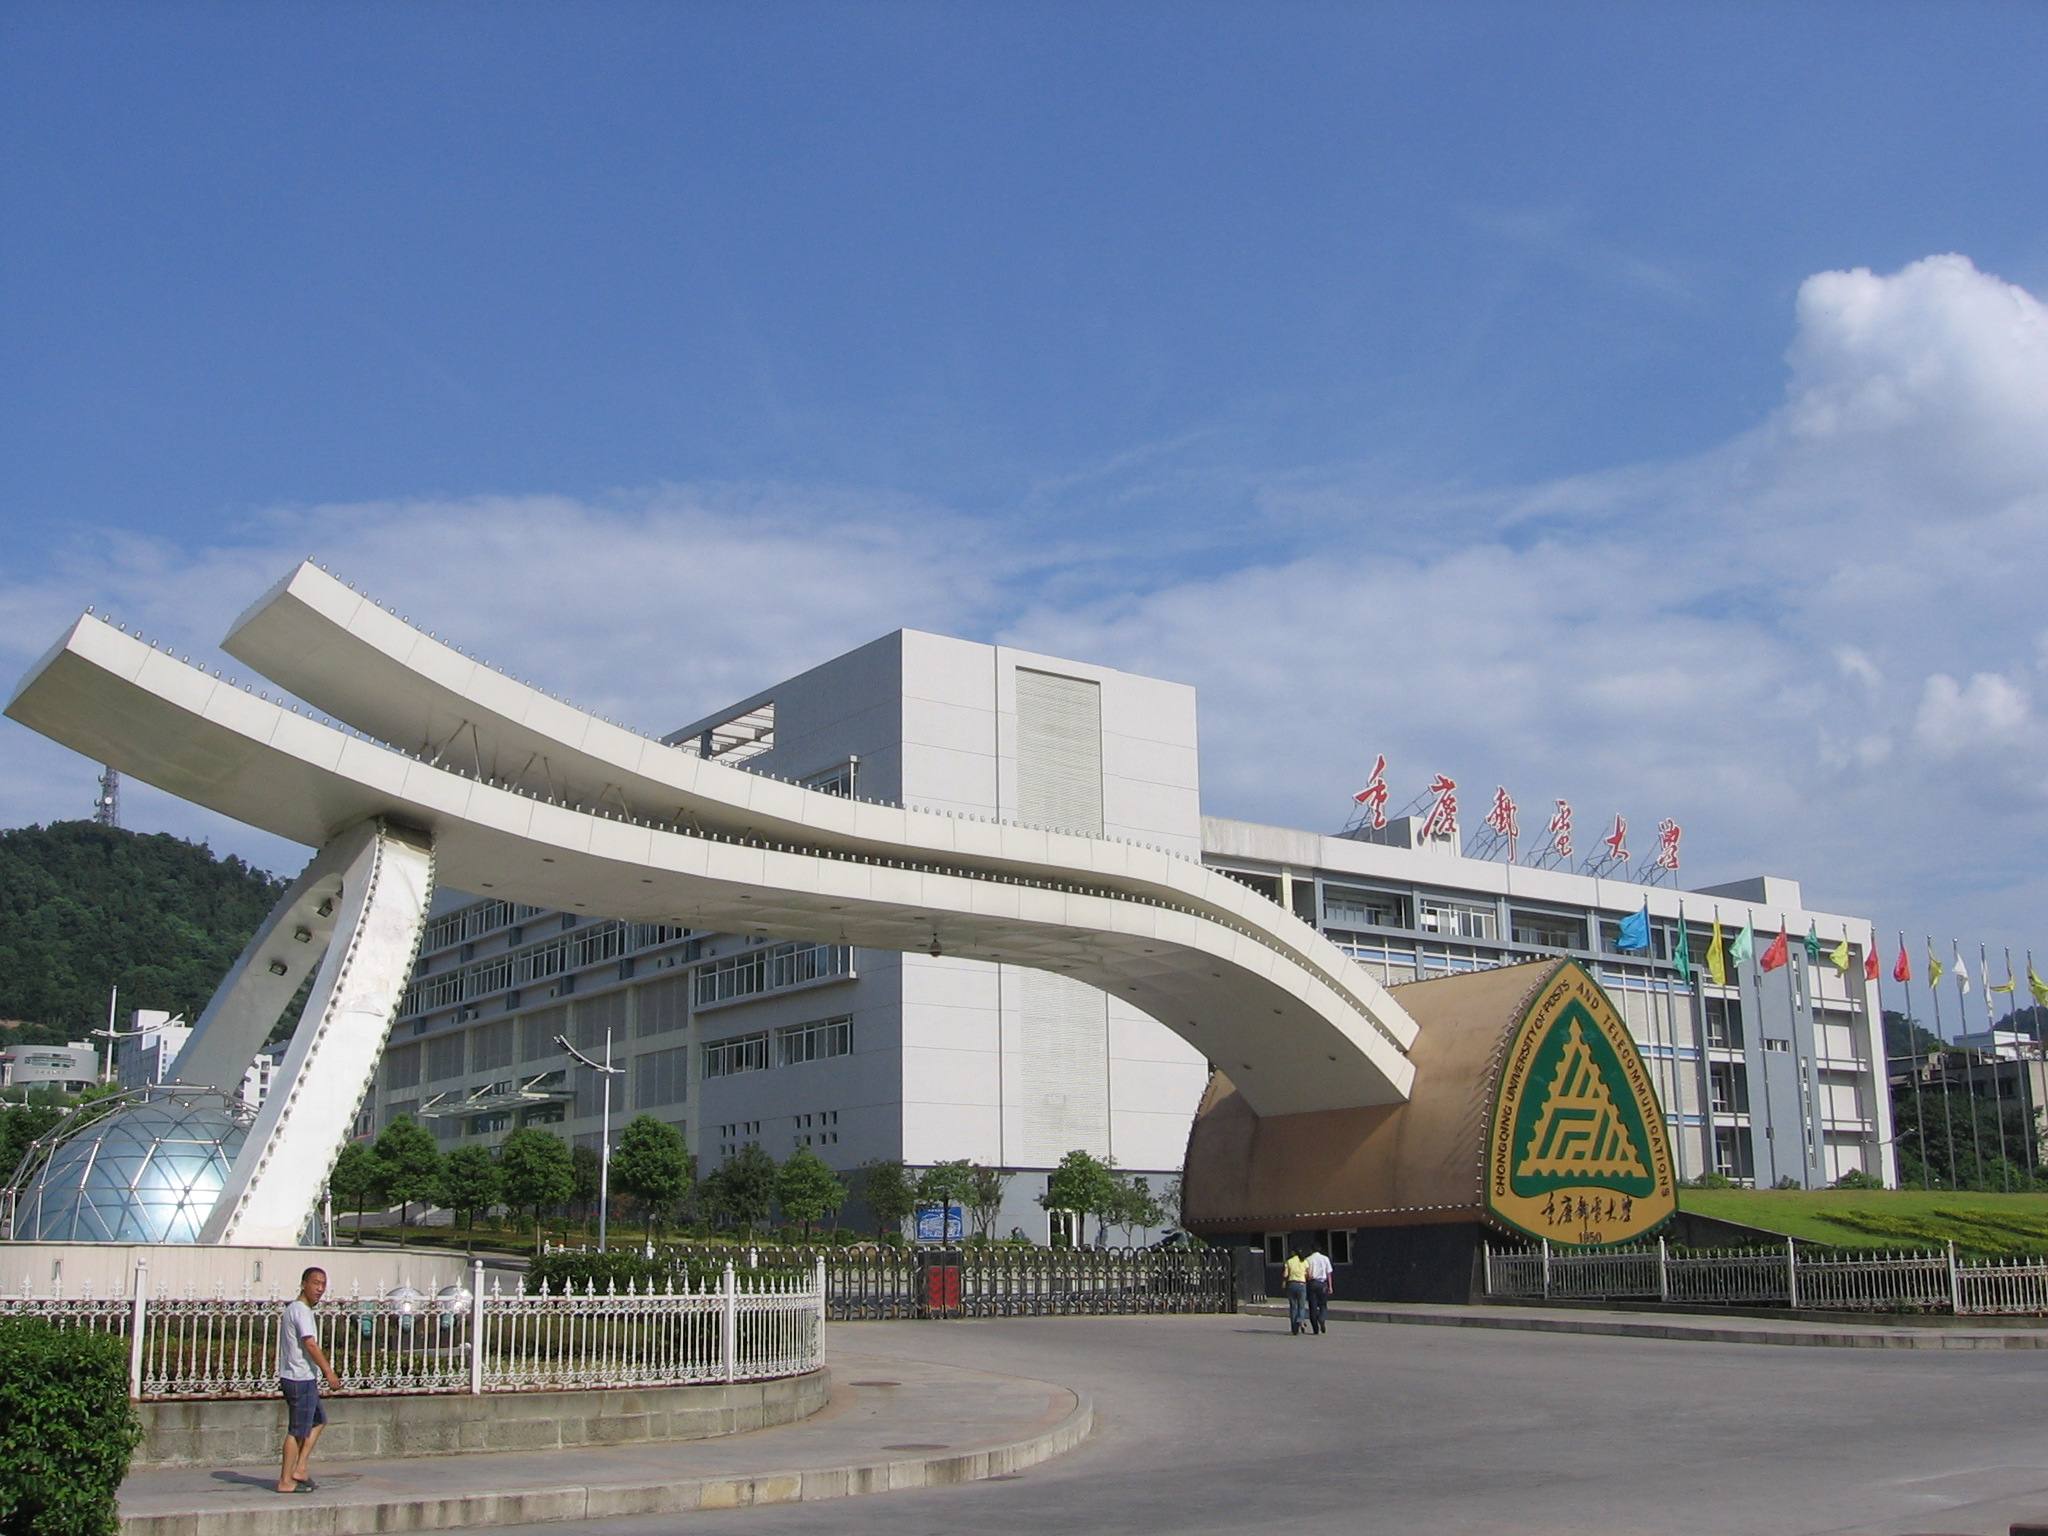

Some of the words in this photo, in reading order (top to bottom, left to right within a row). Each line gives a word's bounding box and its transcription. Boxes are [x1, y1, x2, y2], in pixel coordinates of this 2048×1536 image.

[1495, 1106, 1513, 1197] CHONGQING
[1506, 1025, 1538, 1102] UNIVERSITY
[1534, 1009, 1546, 1030] OF
[1543, 979, 1570, 1013] POSTS
[1575, 982, 1600, 1010] AND
[1602, 1014, 1670, 1198] TELECOMMUNICATIONS
[1579, 1231, 1602, 1244] 1950
